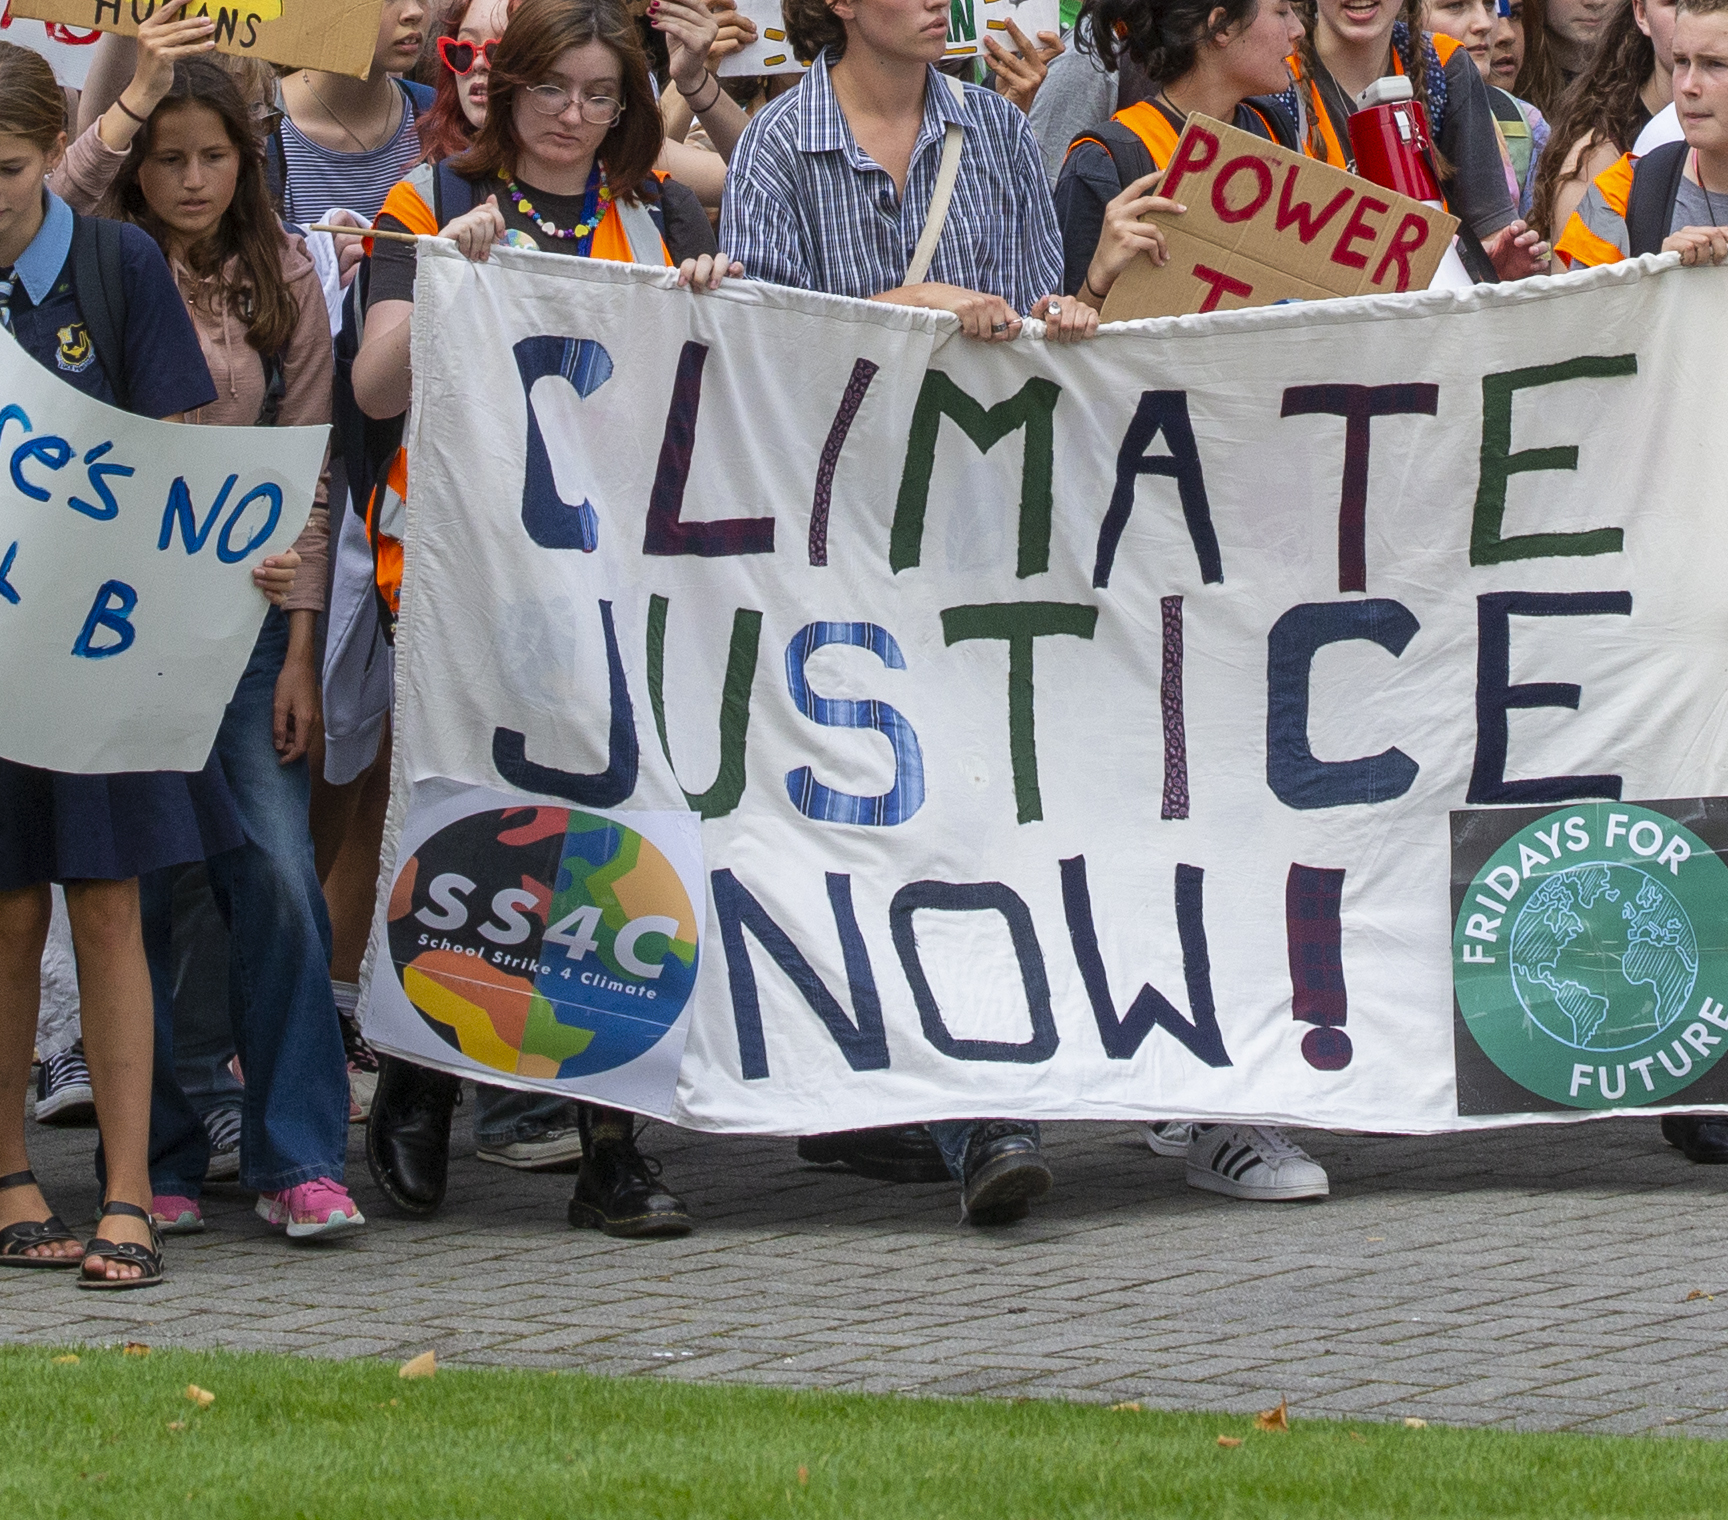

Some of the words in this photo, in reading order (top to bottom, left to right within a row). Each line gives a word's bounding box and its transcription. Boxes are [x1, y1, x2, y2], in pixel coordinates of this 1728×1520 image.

[1158, 124, 1429, 292] POWER
[156, 473, 283, 565] NO
[511, 333, 1638, 593] CLIMATE
[71, 579, 138, 659] B
[490, 590, 1634, 827] JUSTICE
[414, 872, 680, 979] SS4C
[1463, 816, 1590, 964] FRIDAYS
[1605, 813, 1691, 876] FOR
[418, 933, 484, 959] School
[491, 950, 551, 976] Strike
[559, 967, 572, 980] 4
[580, 971, 658, 1000] Climate
[710, 852, 1351, 1082] NOW!
